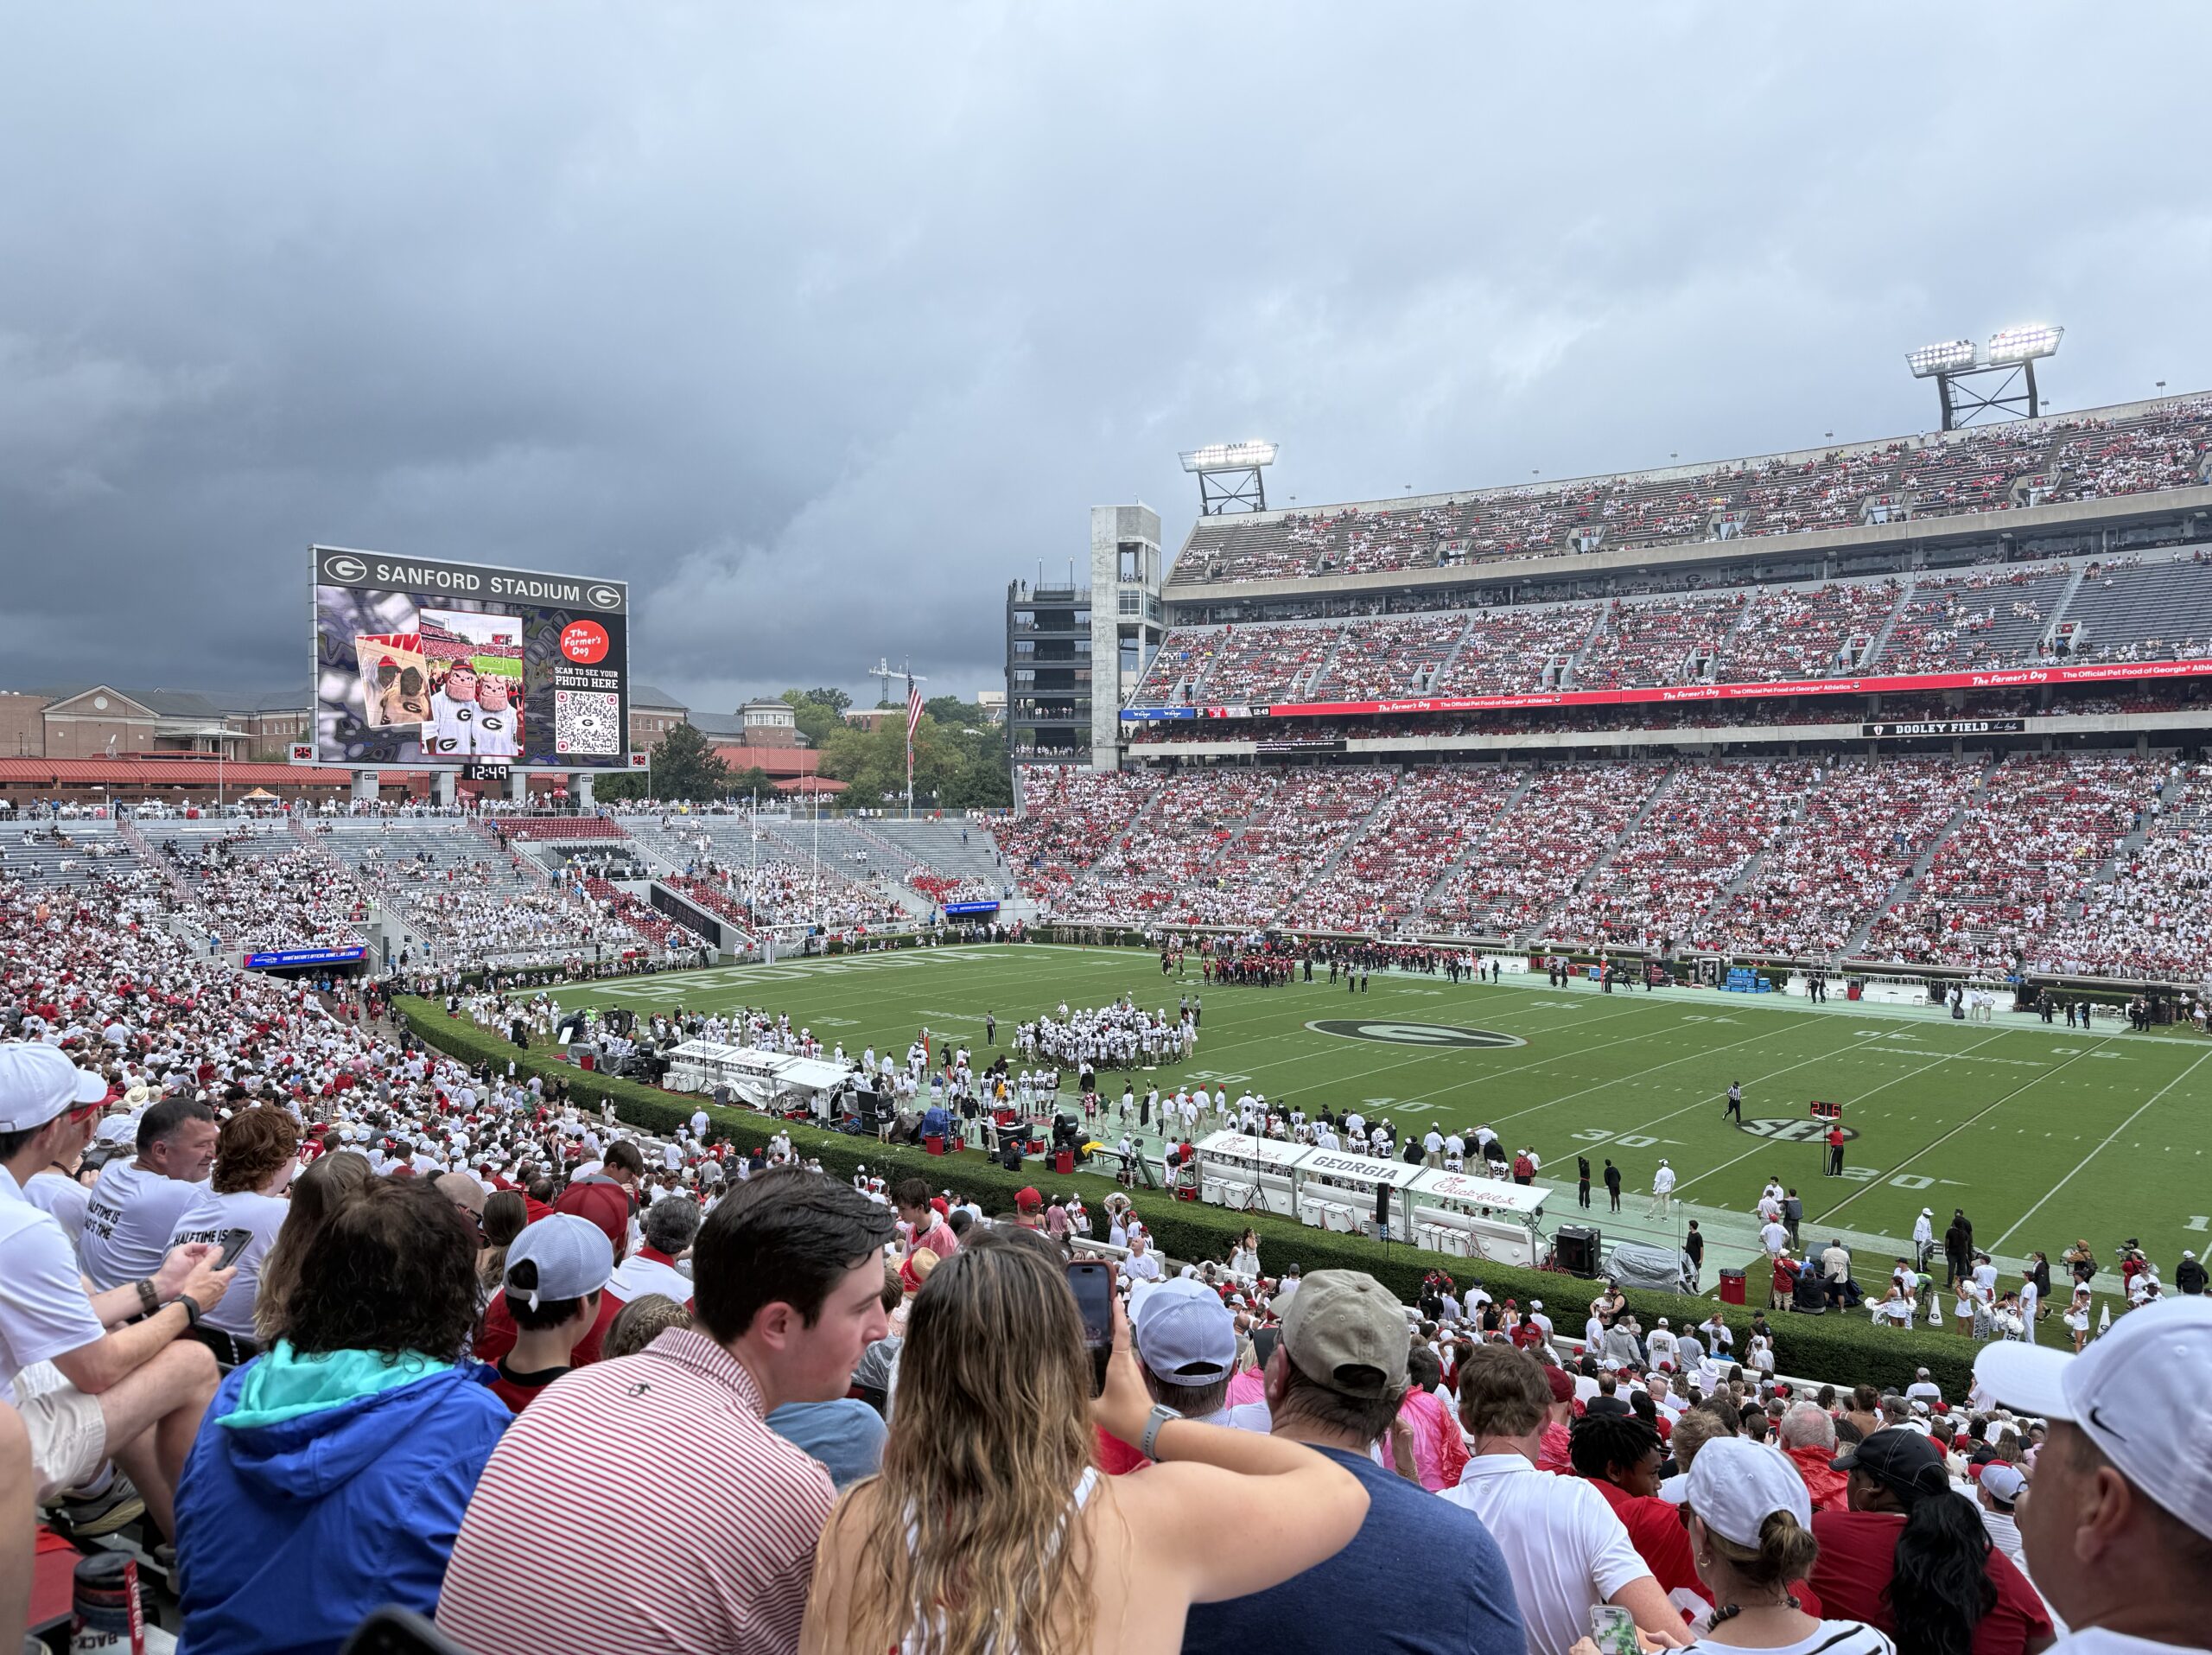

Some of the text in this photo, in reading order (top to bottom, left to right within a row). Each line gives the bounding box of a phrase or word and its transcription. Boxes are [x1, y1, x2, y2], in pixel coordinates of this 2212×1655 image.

[377, 563, 480, 590] SANFORD
[491, 576, 580, 602] STADIUM
[565, 636, 601, 647] Farmer's
[572, 646, 588, 657] Dog
[601, 670, 618, 678] YOUR
[1973, 676, 1989, 685] The
[1991, 674, 2027, 684] Farmer's
[2030, 672, 2047, 681] Dog
[2079, 669, 2106, 678] Official
[555, 676, 618, 689] PHOTO HERE
[1419, 701, 1430, 710] Dog
[1896, 722, 1988, 734] DOOLEY FIELD
[296, 748, 311, 759] 25
[633, 755, 645, 766] 25
[472, 767, 506, 780] 12:49
[589, 951, 1014, 997] GEORGIA
[1185, 1070, 1252, 1084] 50
[1362, 1098, 1434, 1112] 40
[1811, 1102, 1840, 1117] 2:16
[1297, 1128, 1305, 1137] 94
[1317, 1125, 1322, 1134] 7
[1571, 1129, 1660, 1148] 30
[1313, 1156, 1399, 1180] GEORGIA
[1494, 1167, 1504, 1175] 26
[1834, 1167, 1936, 1189] 20
[111, 1212, 121, 1224] IS
[95, 1225, 112, 1240] TIME
[174, 1229, 229, 1247] HALFTIME IS
